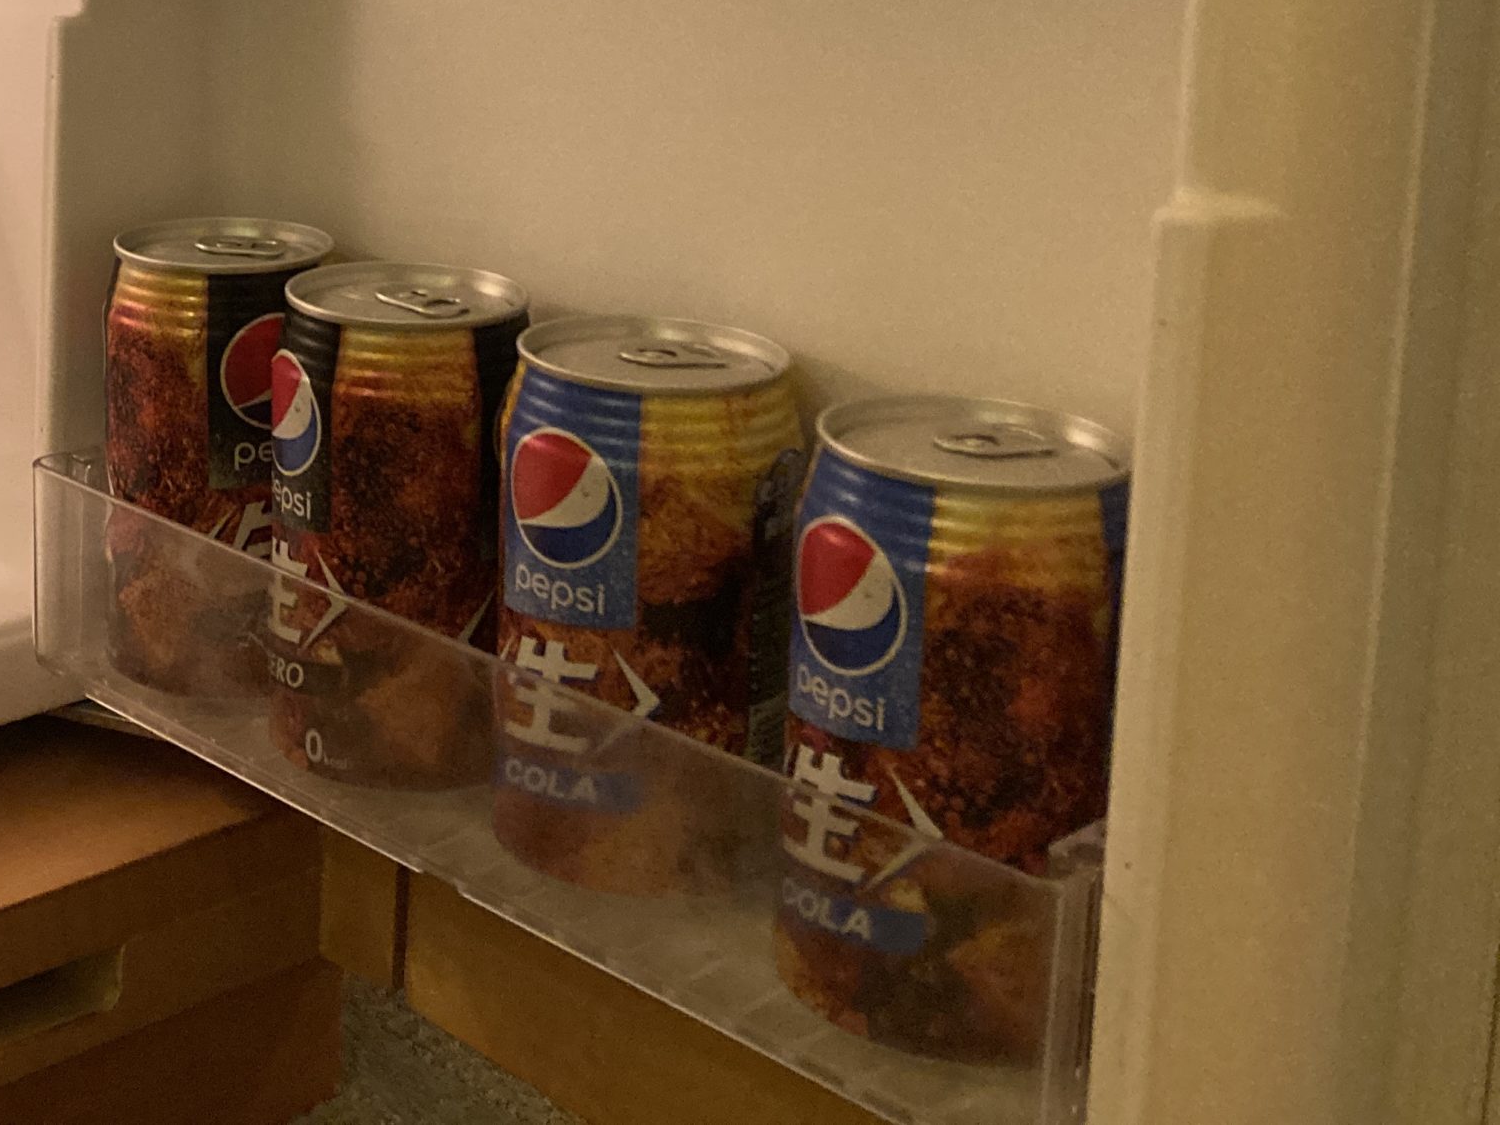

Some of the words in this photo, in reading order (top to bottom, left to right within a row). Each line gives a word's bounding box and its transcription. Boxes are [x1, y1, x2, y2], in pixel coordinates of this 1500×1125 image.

[272, 478, 312, 521] epsi
[514, 562, 606, 617] pepsi
[796, 663, 886, 732] pepsi
[504, 757, 597, 804] COLA
